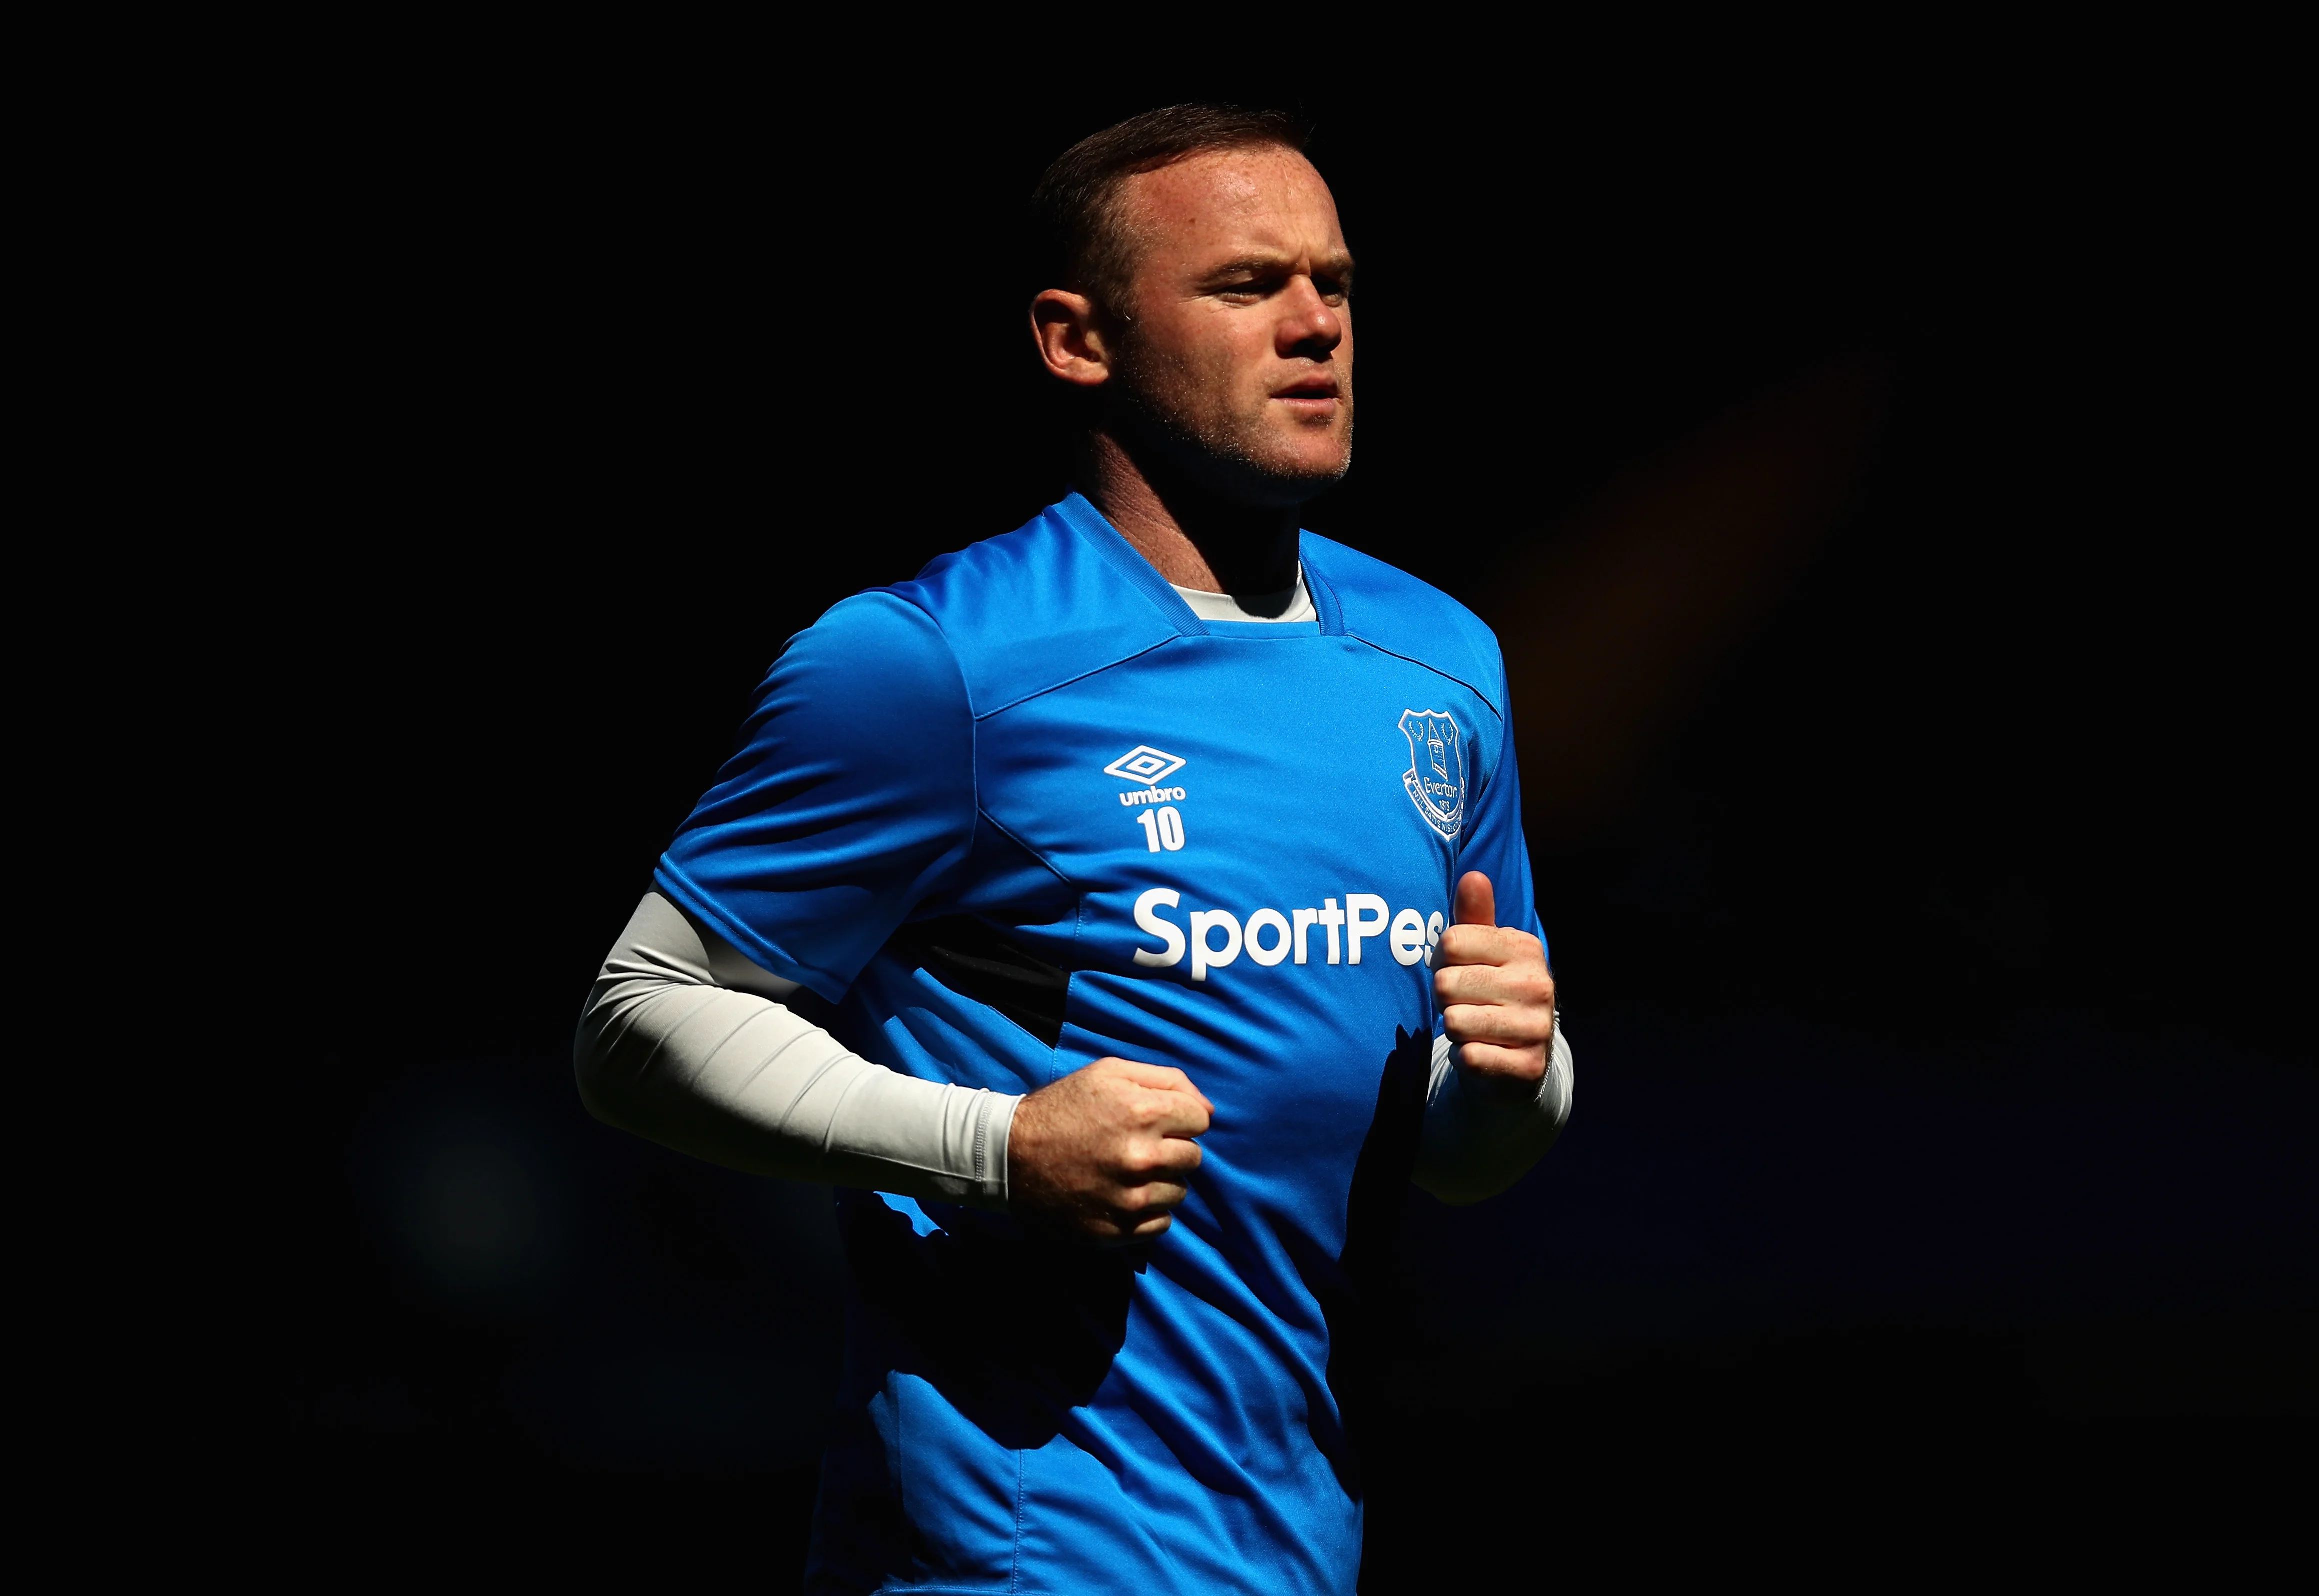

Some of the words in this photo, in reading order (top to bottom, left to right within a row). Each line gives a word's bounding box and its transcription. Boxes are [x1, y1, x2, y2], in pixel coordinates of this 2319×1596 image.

[1120, 786, 1186, 806] umbro
[1423, 777, 1457, 798] Everton
[1413, 789, 1424, 808] NIL
[1137, 806, 1185, 852] 10
[1133, 888, 1449, 981] SportPes
